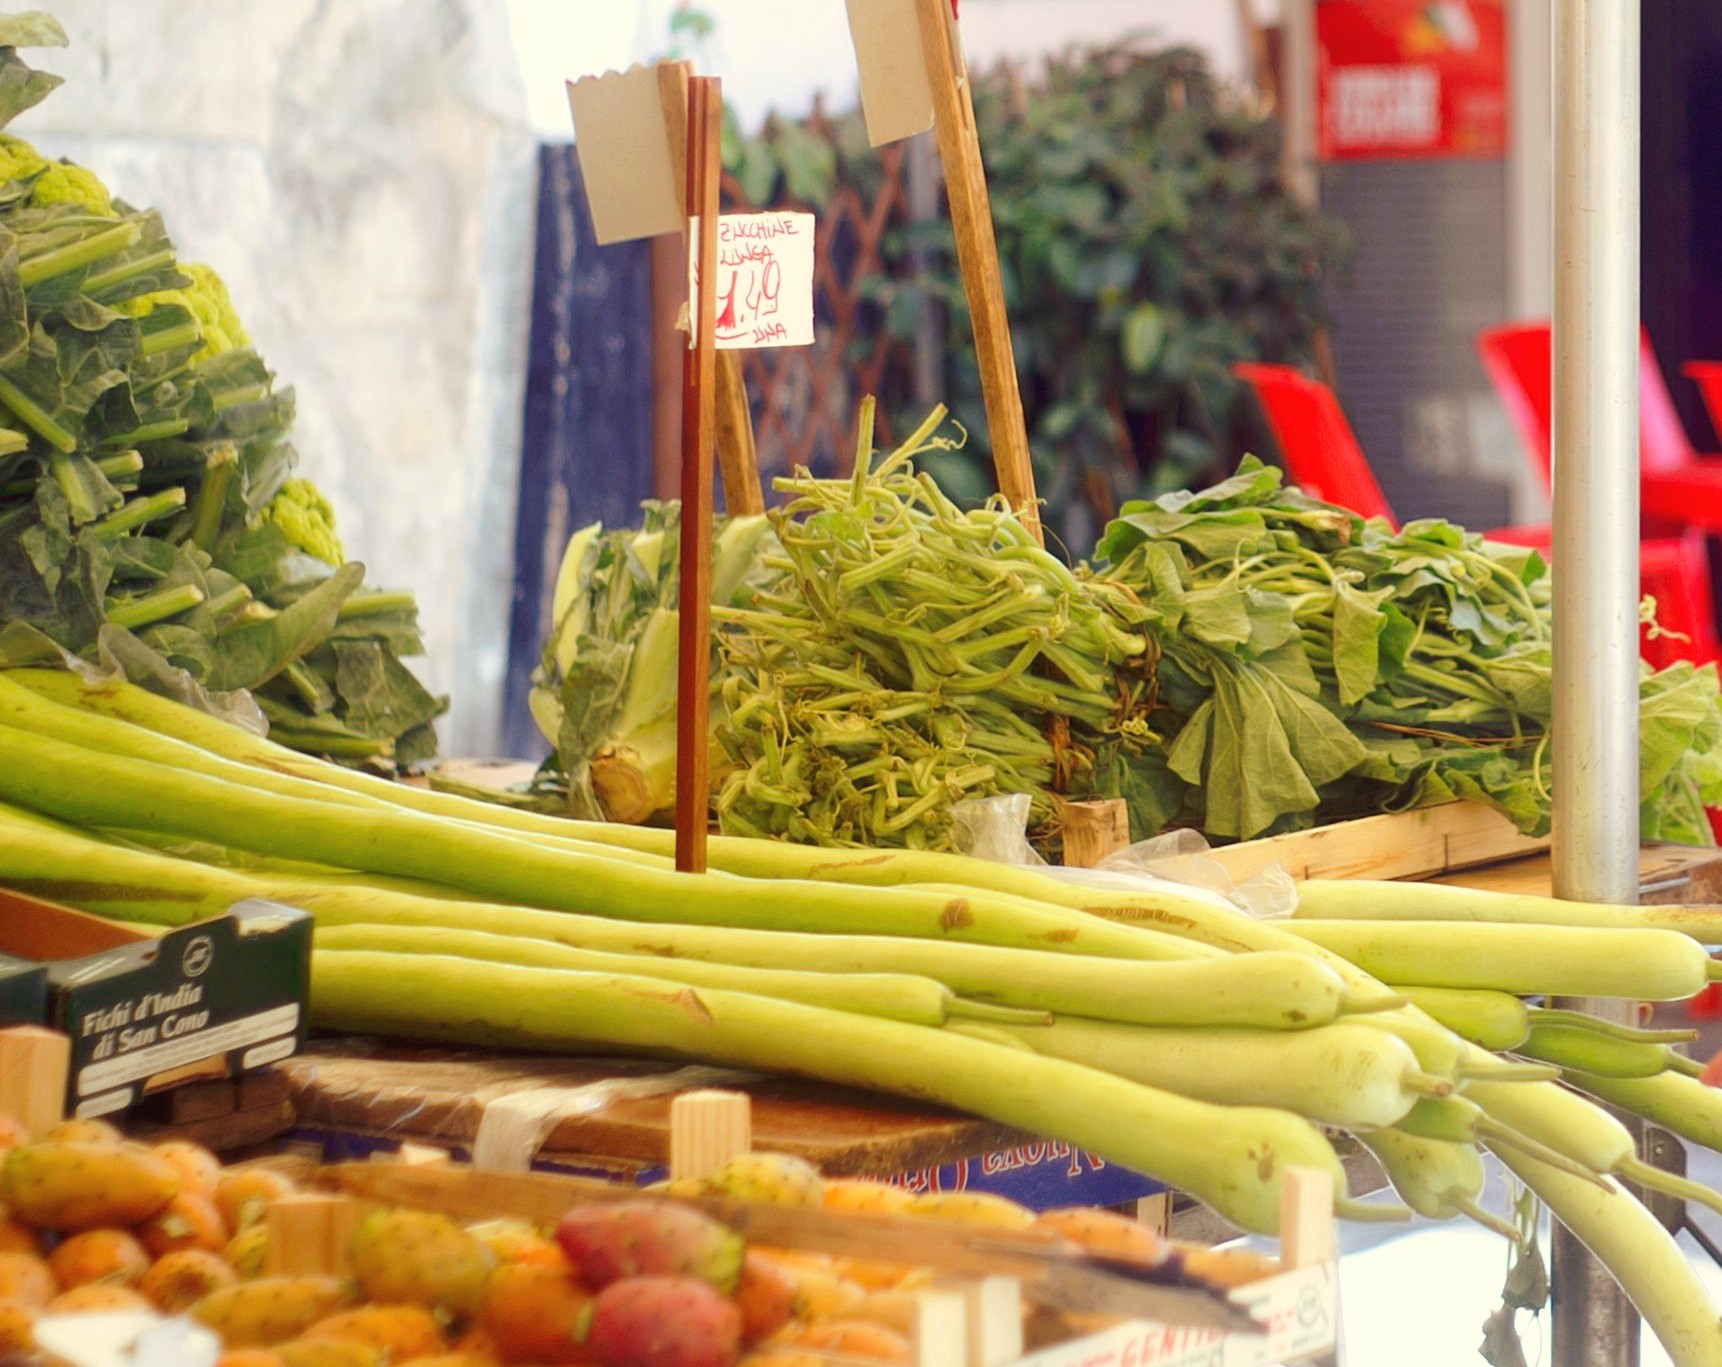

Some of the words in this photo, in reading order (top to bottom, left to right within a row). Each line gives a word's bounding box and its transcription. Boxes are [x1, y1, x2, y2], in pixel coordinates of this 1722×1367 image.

[719, 243, 773, 267] LUNGA
[716, 260, 781, 331] 1.49
[752, 322, 788, 345] UNA
[82, 1000, 134, 1037] Fichi
[134, 982, 203, 1021] d'India
[92, 1031, 117, 1061] di
[118, 1027, 157, 1053] San
[161, 1009, 210, 1039] Cono
